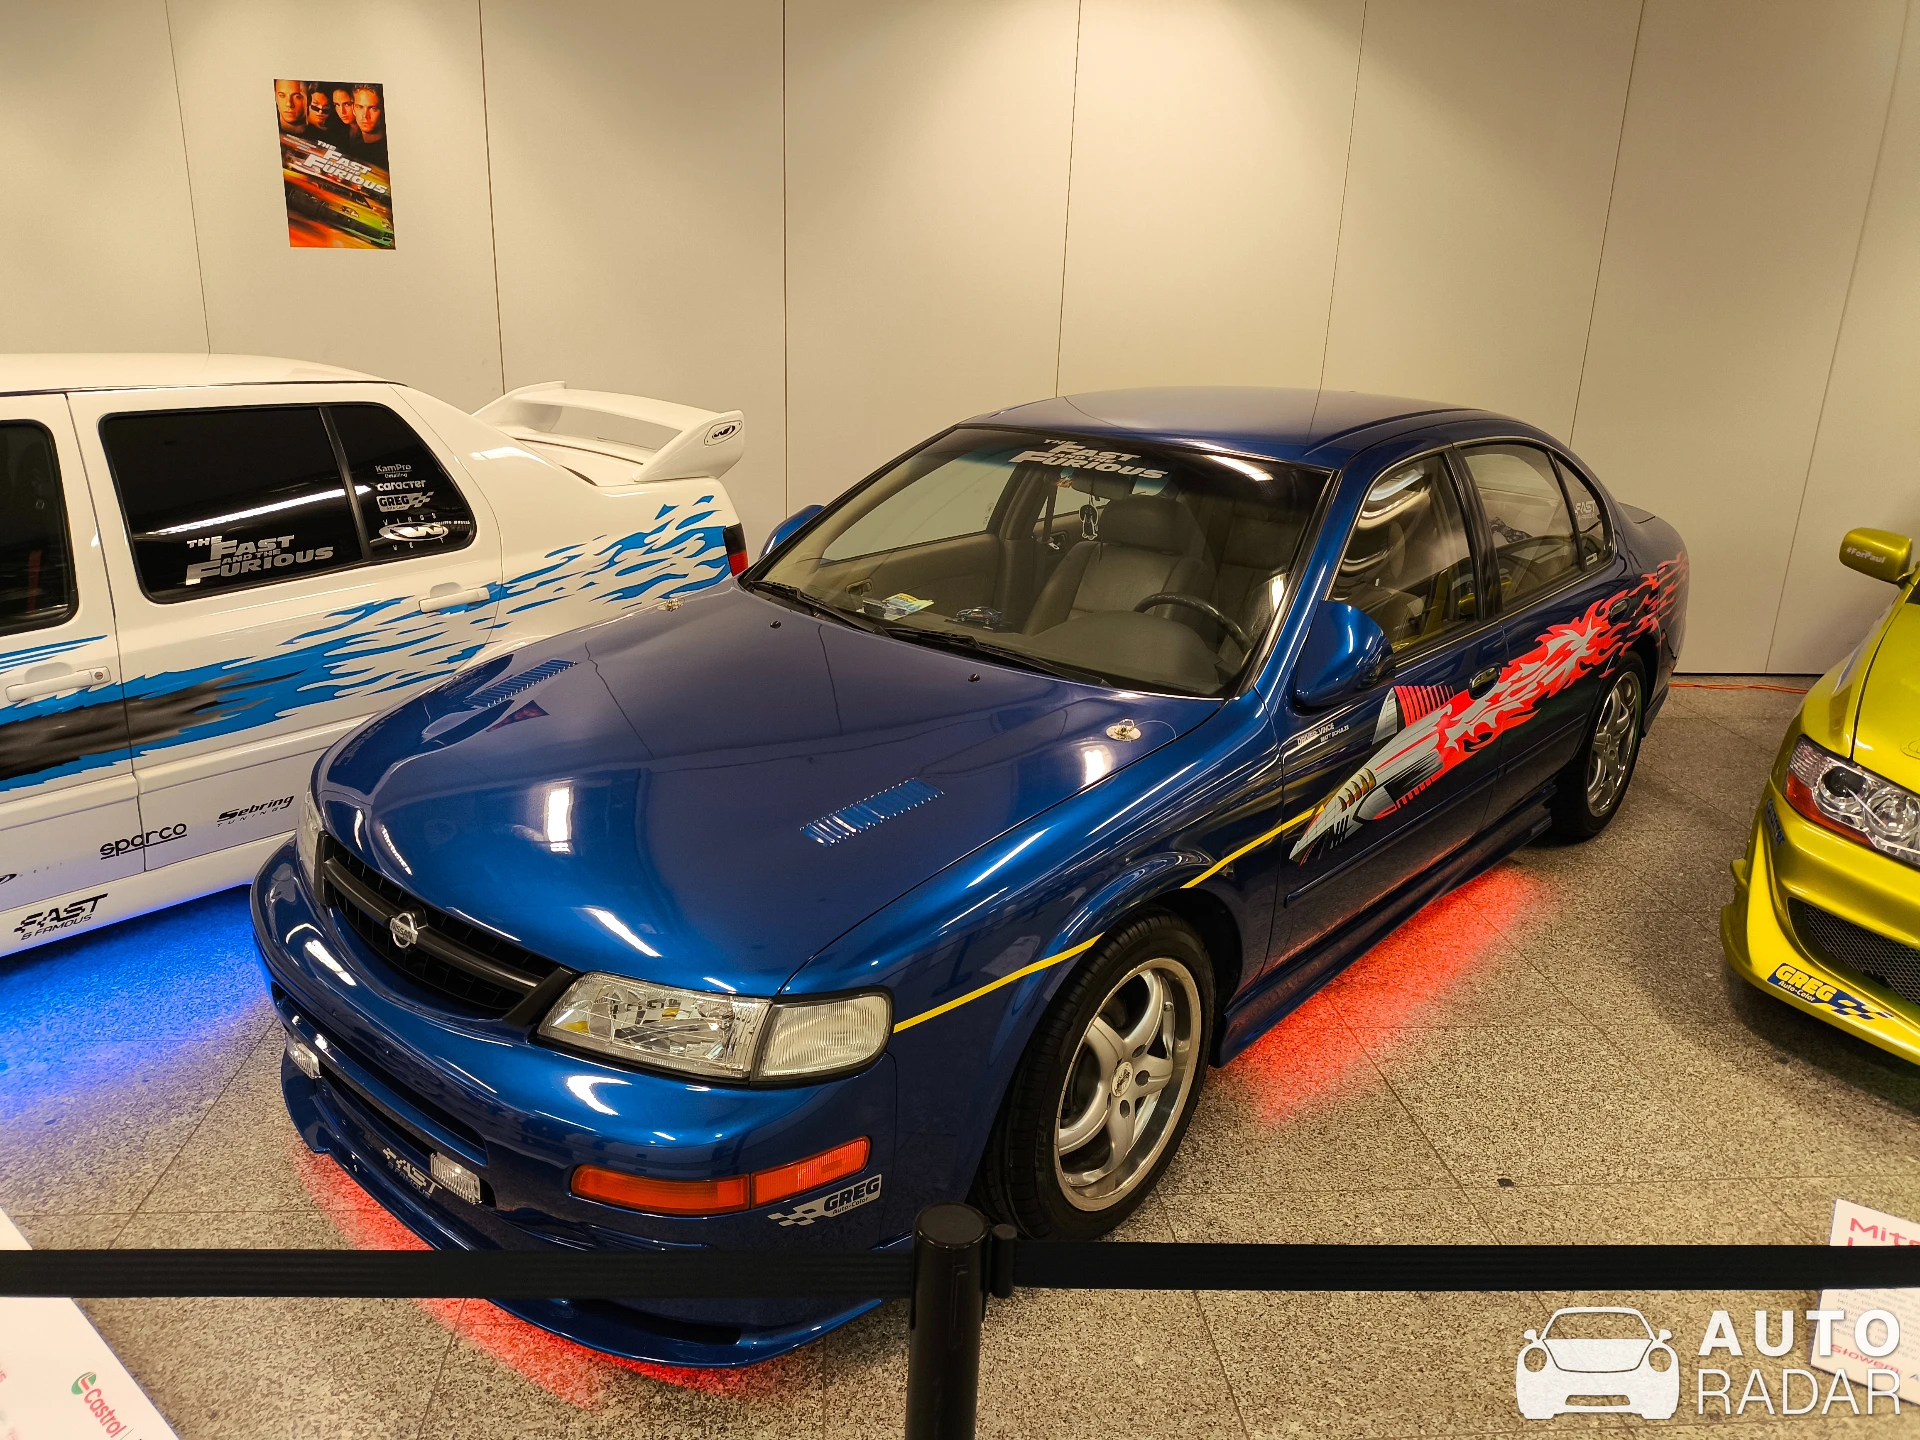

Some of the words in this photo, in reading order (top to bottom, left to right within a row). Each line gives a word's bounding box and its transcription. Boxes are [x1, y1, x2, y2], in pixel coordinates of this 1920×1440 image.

[317, 140, 337, 151] THE
[303, 154, 388, 194] FURIOUS
[323, 149, 372, 174] FAST
[1049, 442, 1141, 461] FAST
[1008, 450, 1169, 479] FURIOUS
[379, 495, 410, 507] GREG
[187, 536, 223, 549] THE
[210, 534, 295, 561] FAST
[185, 546, 334, 586] FURIOUS
[222, 553, 253, 565] AND
[255, 548, 281, 559] THE
[1846, 547, 1887, 564] #ForPaul
[216, 807, 279, 828] TUNING
[217, 795, 295, 822] Sebring
[100, 823, 187, 858] sparco
[13, 893, 109, 934] FAST
[34, 913, 93, 937] FAMOUS
[391, 922, 413, 941] NISSAN
[1775, 964, 1838, 1002] GREG
[1778, 980, 1816, 1002] Auto-Color
[382, 1147, 443, 1194] FAST
[823, 1176, 881, 1212] GREG
[832, 1196, 869, 1215] Auto-Color
[84, 1388, 128, 1439] Castrol
